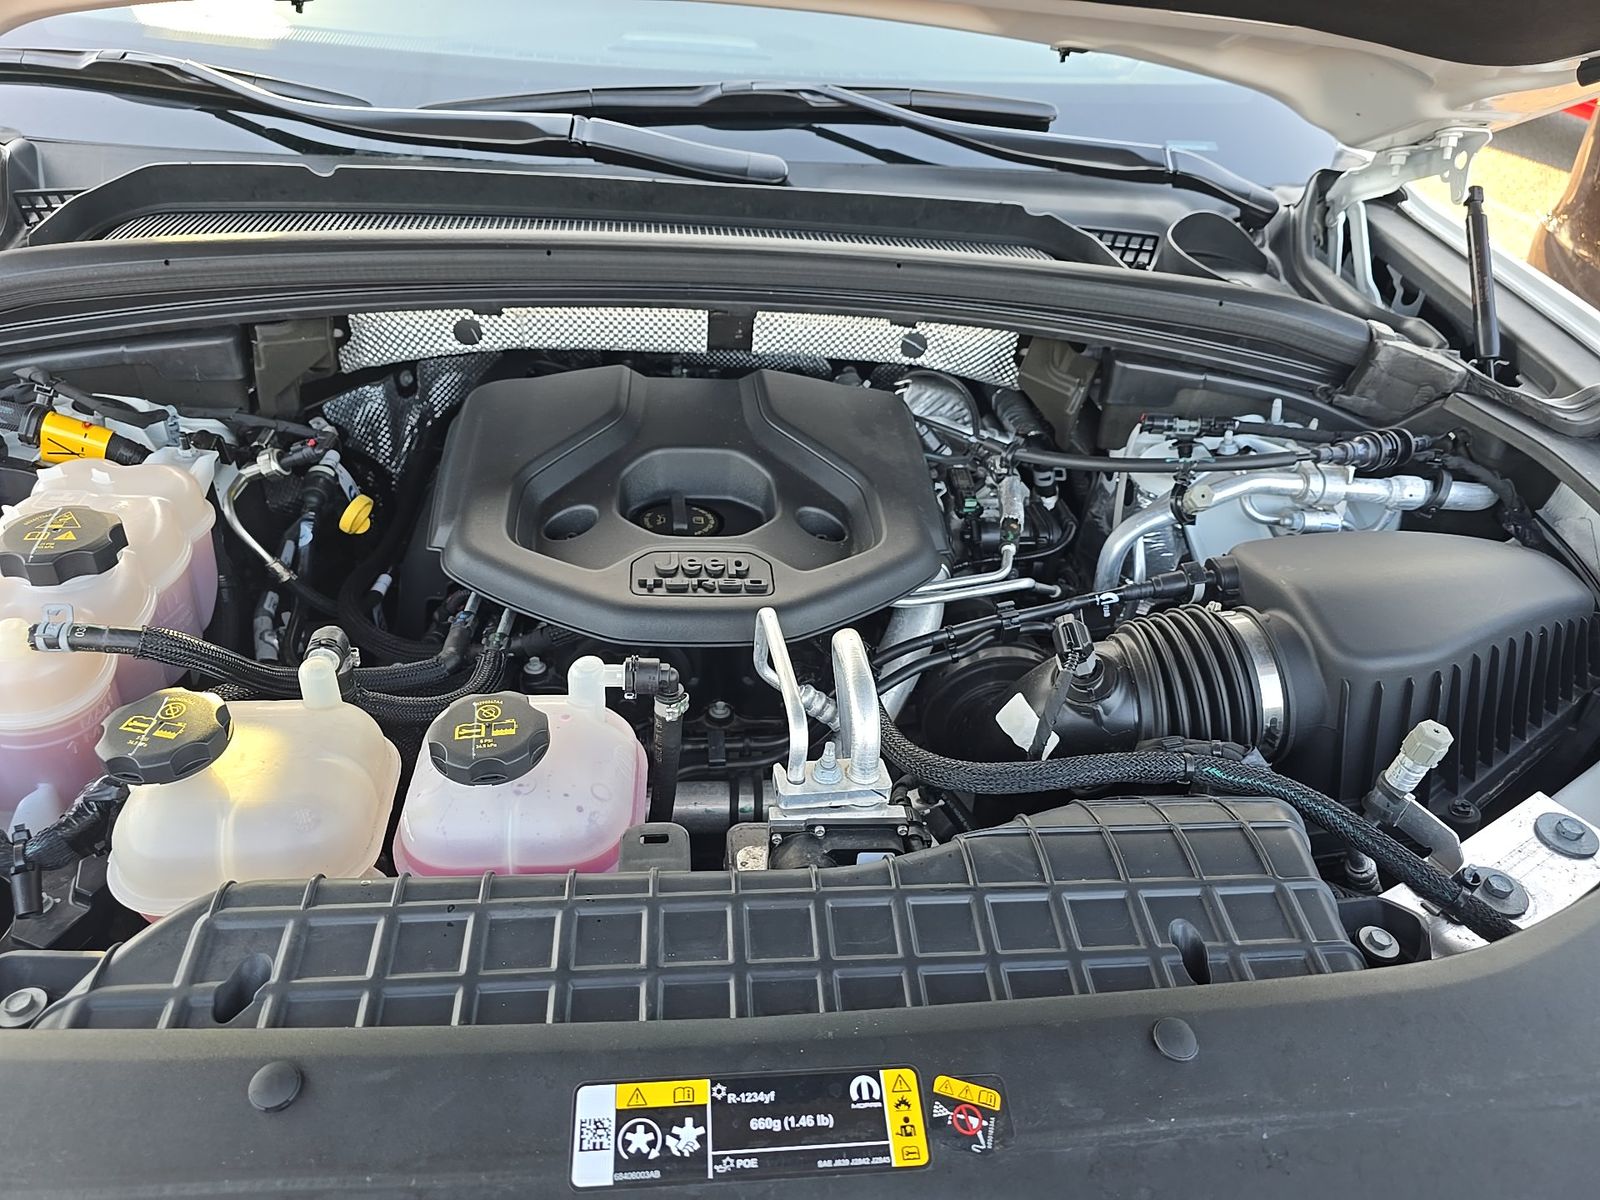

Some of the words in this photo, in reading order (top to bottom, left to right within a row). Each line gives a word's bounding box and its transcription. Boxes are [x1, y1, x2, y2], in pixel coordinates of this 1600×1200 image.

[655, 552, 750, 578] Jeep
[638, 578, 769, 593] TURBO
[727, 1090, 776, 1105] R-1234yf
[750, 1117, 782, 1132] 660g
[784, 1114, 814, 1131] (1.46
[817, 1113, 835, 1128] lb)
[736, 1157, 759, 1169] POE
[817, 1160, 833, 1168] SAE
